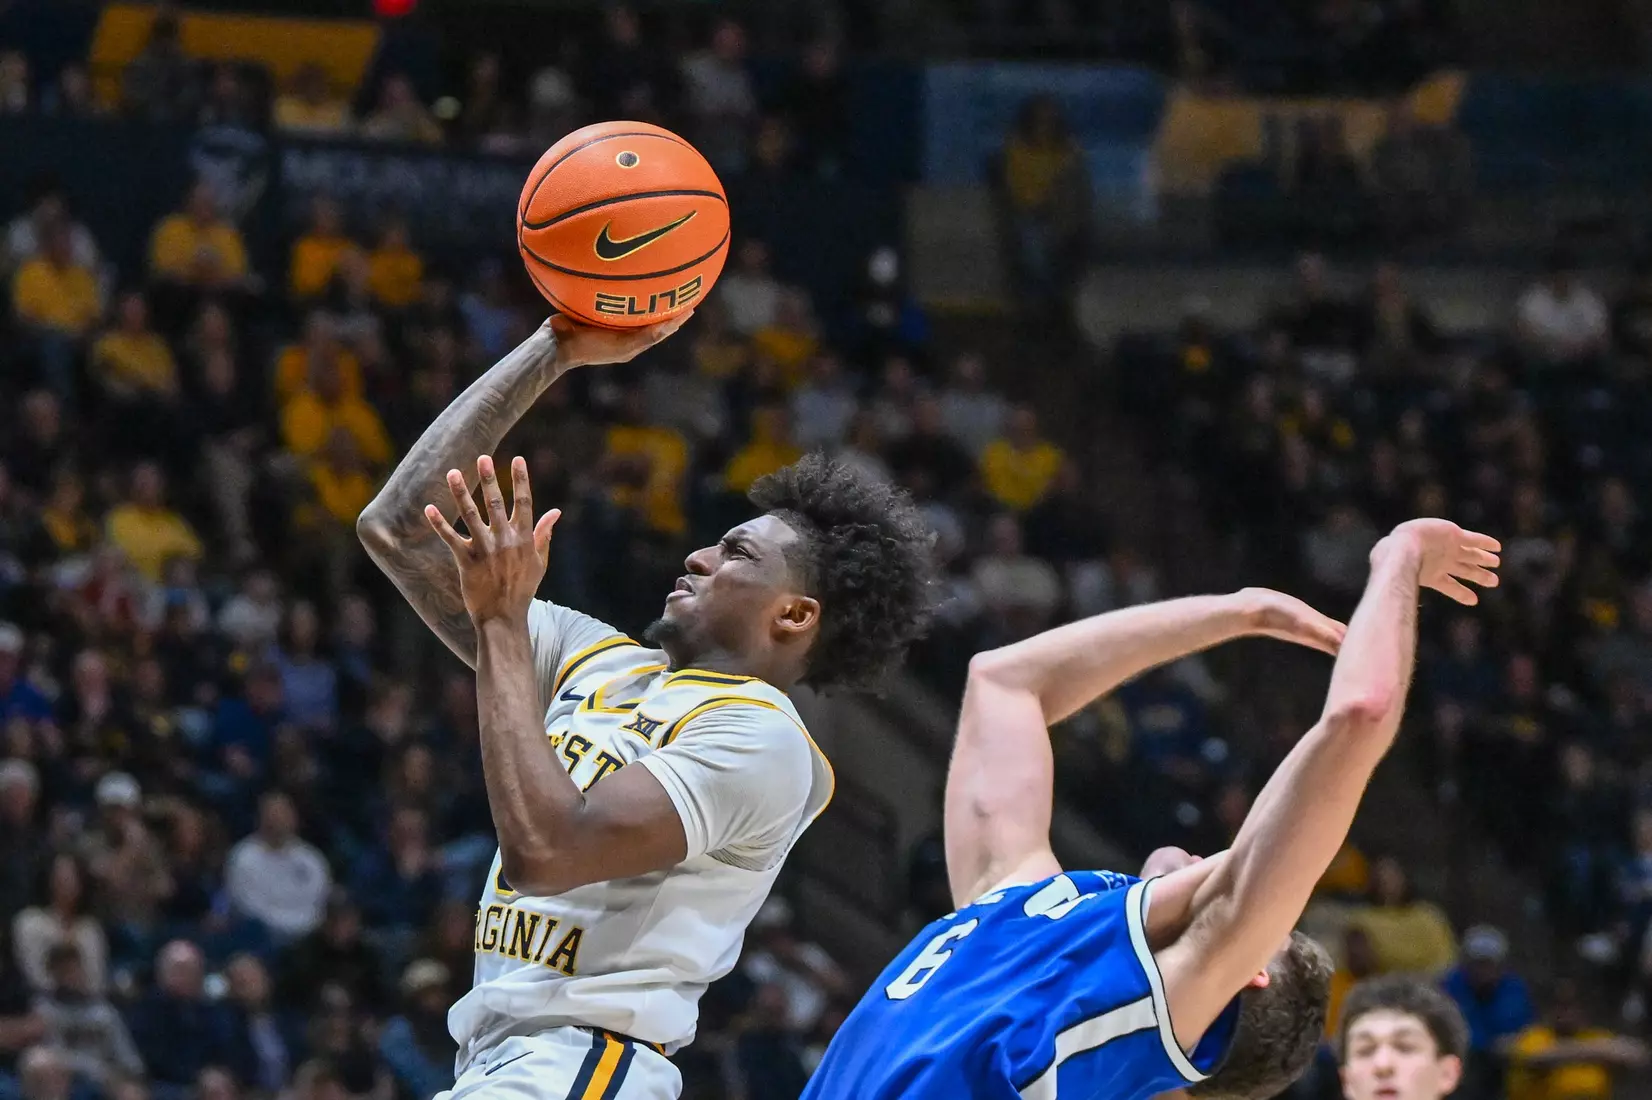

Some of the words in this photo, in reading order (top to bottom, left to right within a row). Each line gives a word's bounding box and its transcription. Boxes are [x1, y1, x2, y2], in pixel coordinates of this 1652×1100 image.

[595, 273, 703, 316] ELITE
[548, 729, 628, 794] ST
[885, 917, 980, 1001] 6
